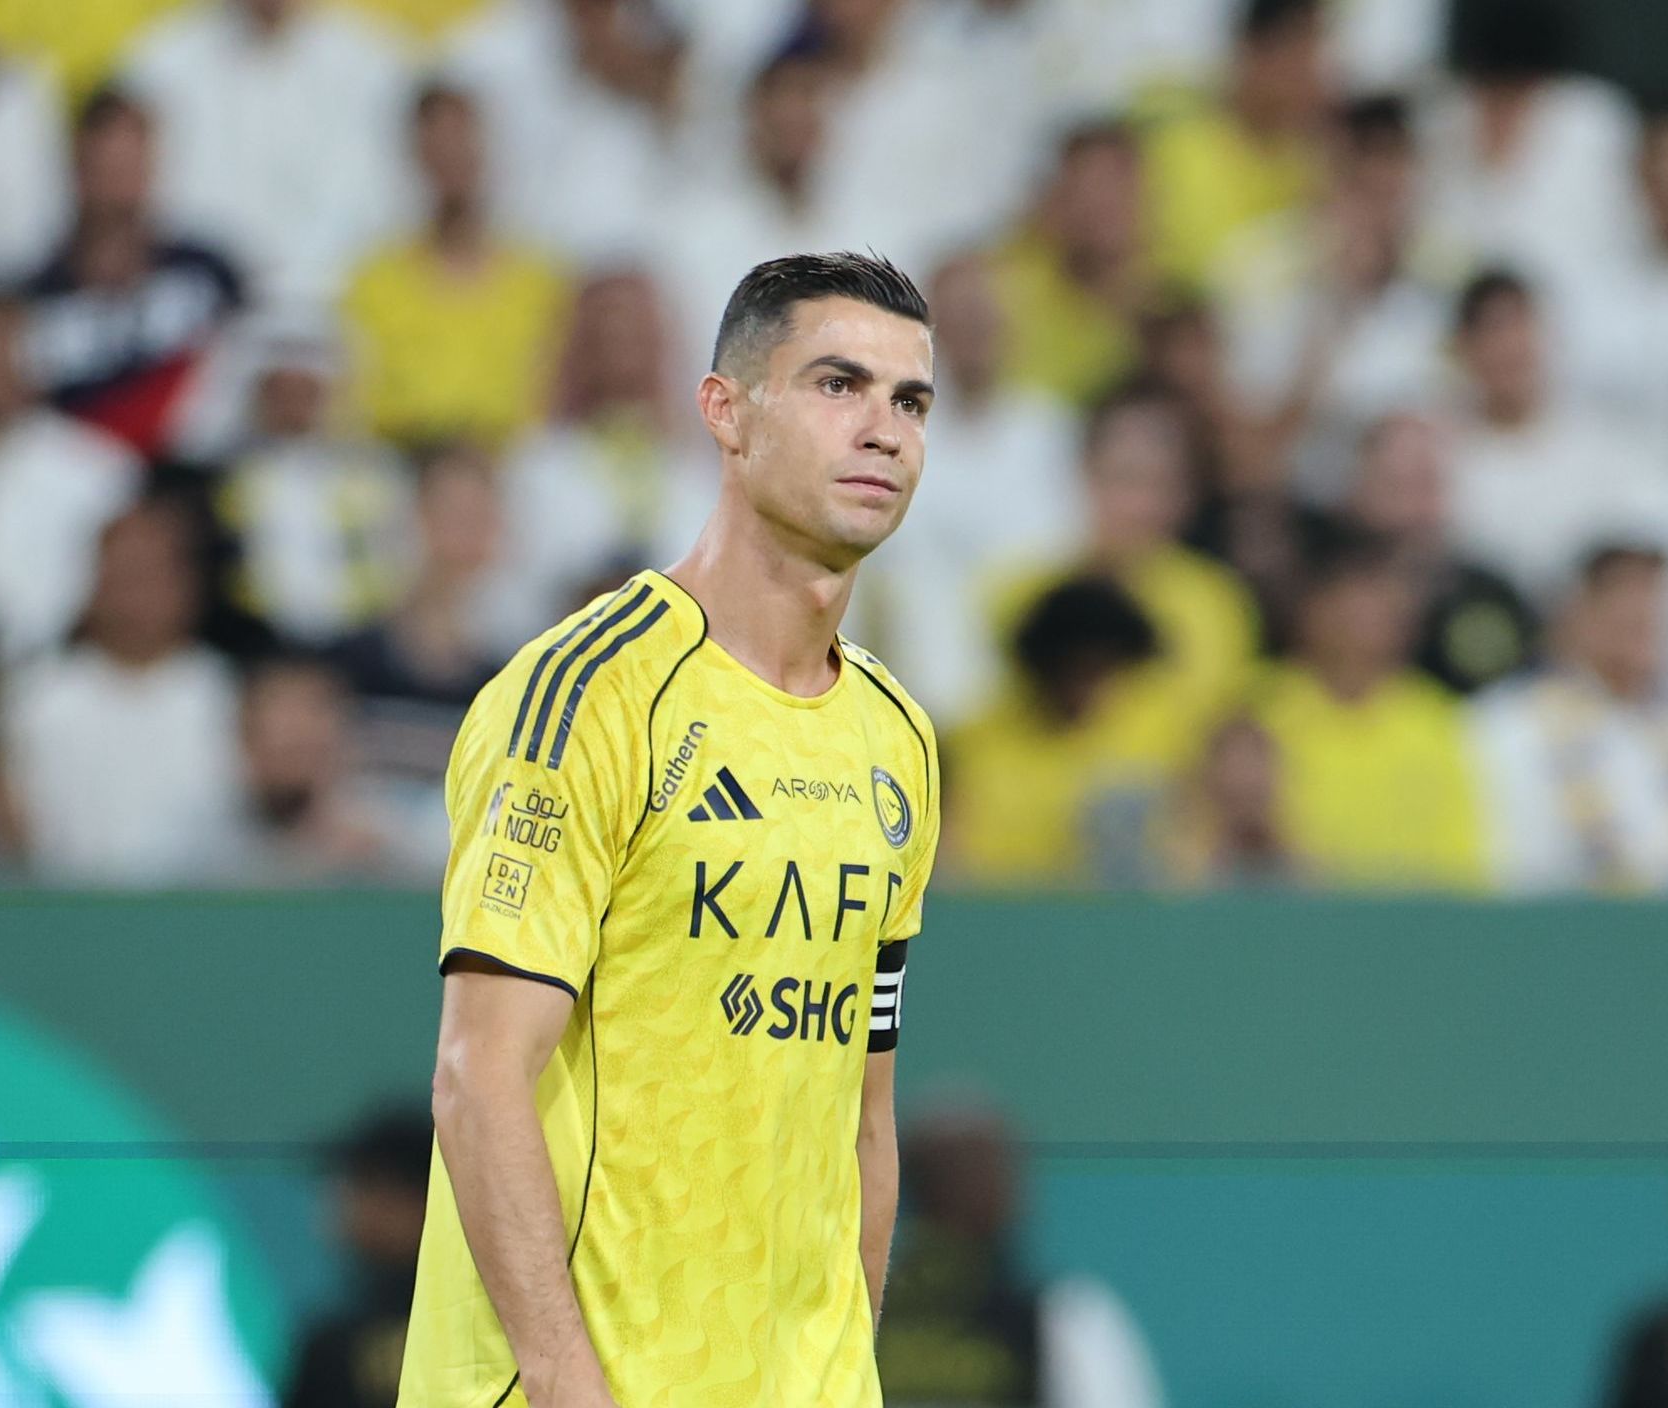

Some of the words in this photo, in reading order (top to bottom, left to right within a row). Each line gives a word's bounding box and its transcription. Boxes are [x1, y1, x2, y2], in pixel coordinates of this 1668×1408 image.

[650, 721, 708, 812] Gathern
[505, 814, 561, 853] NOUG
[767, 977, 859, 1046] SHG
